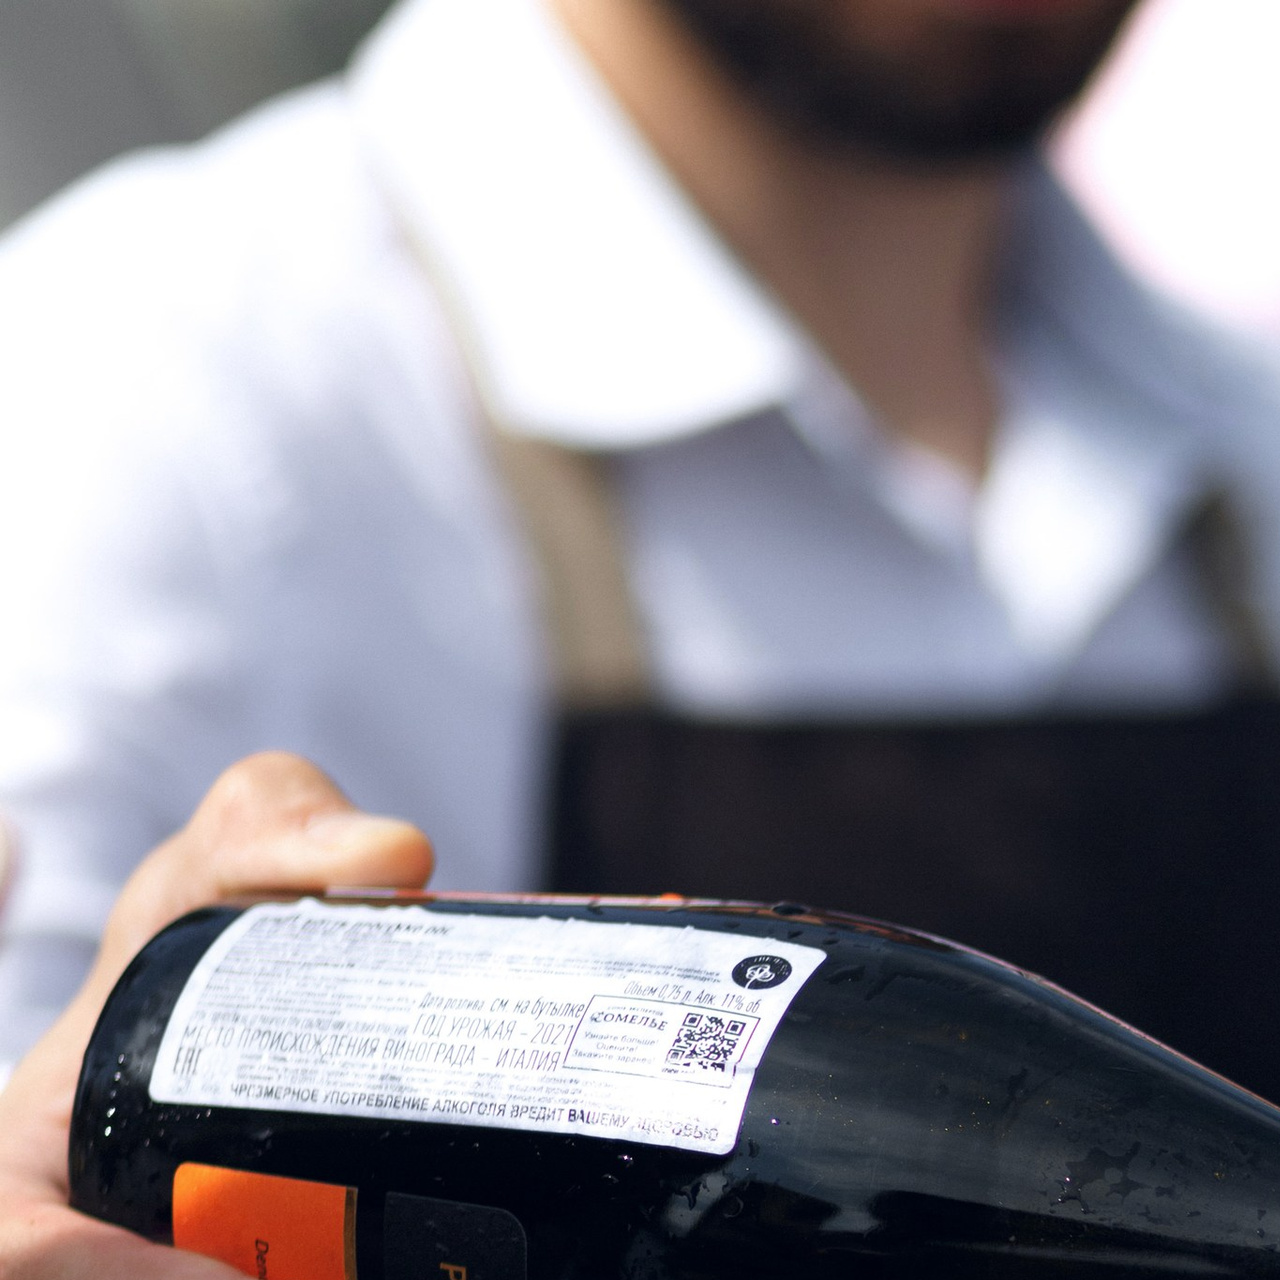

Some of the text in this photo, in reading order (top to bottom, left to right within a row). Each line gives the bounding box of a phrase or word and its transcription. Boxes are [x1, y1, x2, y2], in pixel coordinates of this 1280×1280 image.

[531, 996, 585, 1020] бутылке
[721, 993, 745, 1011] 11%
[413, 1013, 446, 1039] ГОД
[446, 1016, 518, 1041] УРОЖАЯ
[530, 1022, 574, 1046] 2021
[237, 1027, 381, 1061] ПРОИСХОЖДЕНИЯ
[382, 1038, 476, 1067] ВИНОГРАДА
[496, 1048, 561, 1072] ИТАЛИЯ
[323, 1089, 430, 1111] УПОТРЕБЛЕНИЕ
[432, 1099, 507, 1117] АЛКОГОЛЯ
[510, 1104, 565, 1122] ВРЕДИТ
[568, 1108, 630, 1128] ВАШЕМУ
